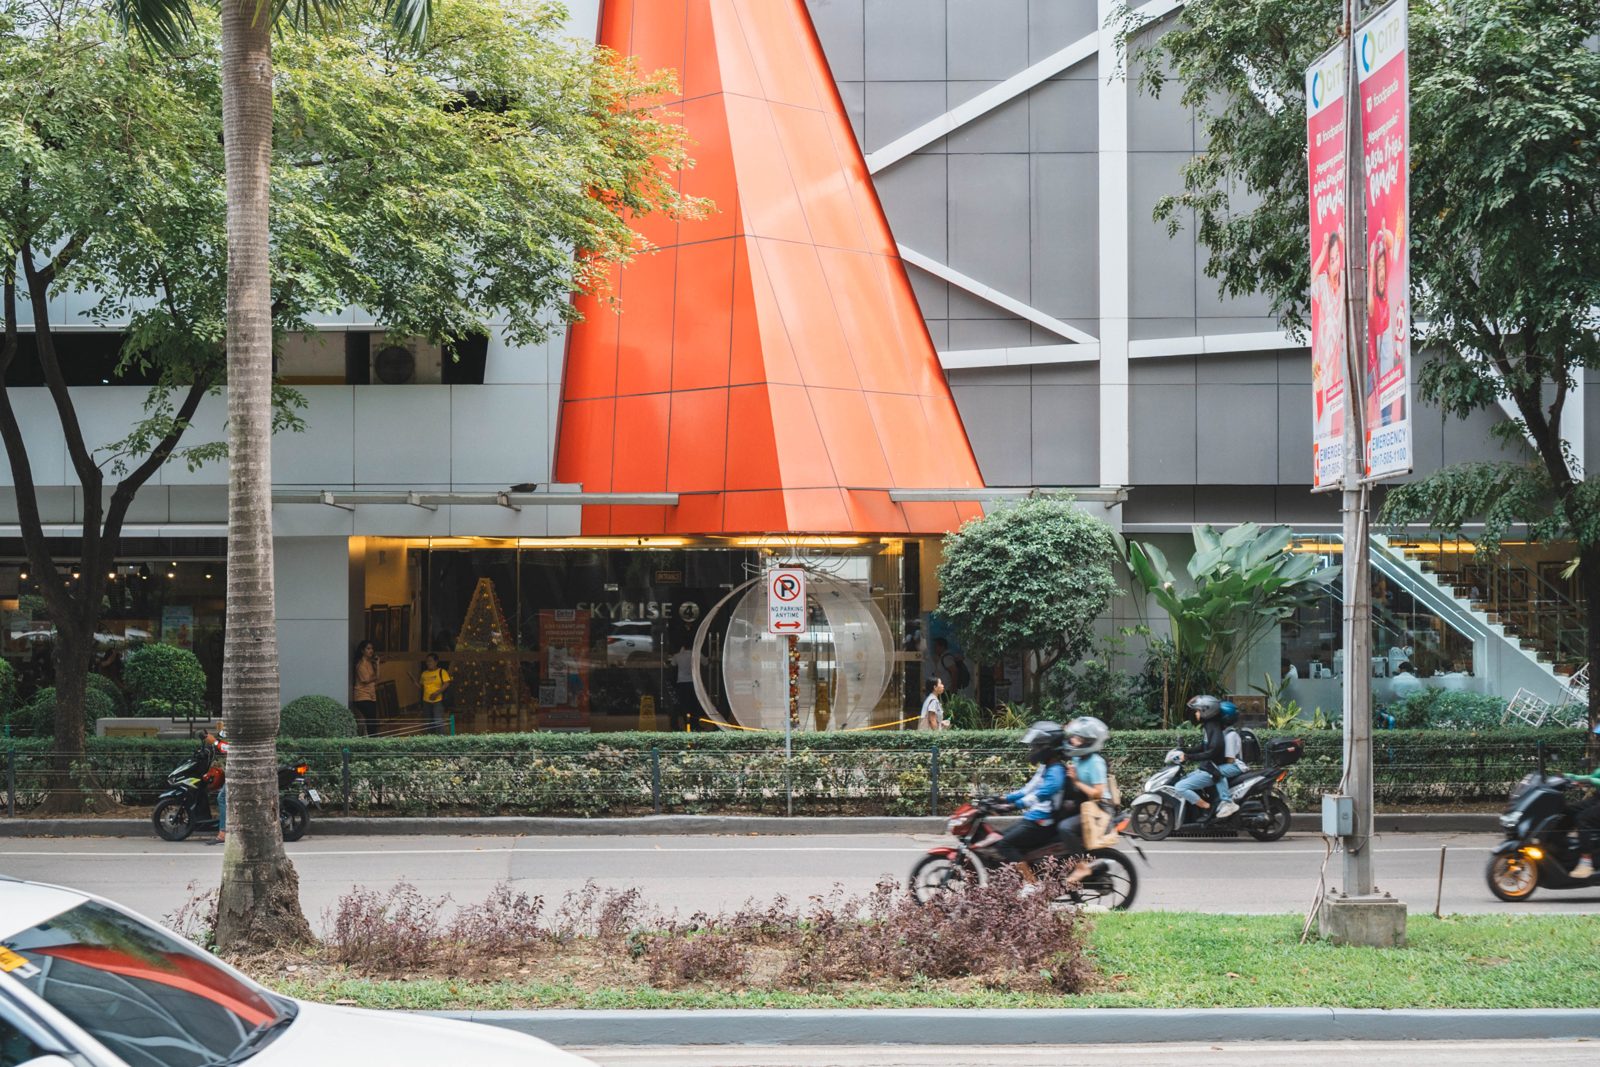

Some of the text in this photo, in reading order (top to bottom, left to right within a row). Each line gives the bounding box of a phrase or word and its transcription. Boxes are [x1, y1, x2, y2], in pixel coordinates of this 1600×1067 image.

[1377, 18, 1400, 53] CITP
[1372, 428, 1407, 451] EMERGENCY
[1320, 443, 1342, 462] EMERGE
